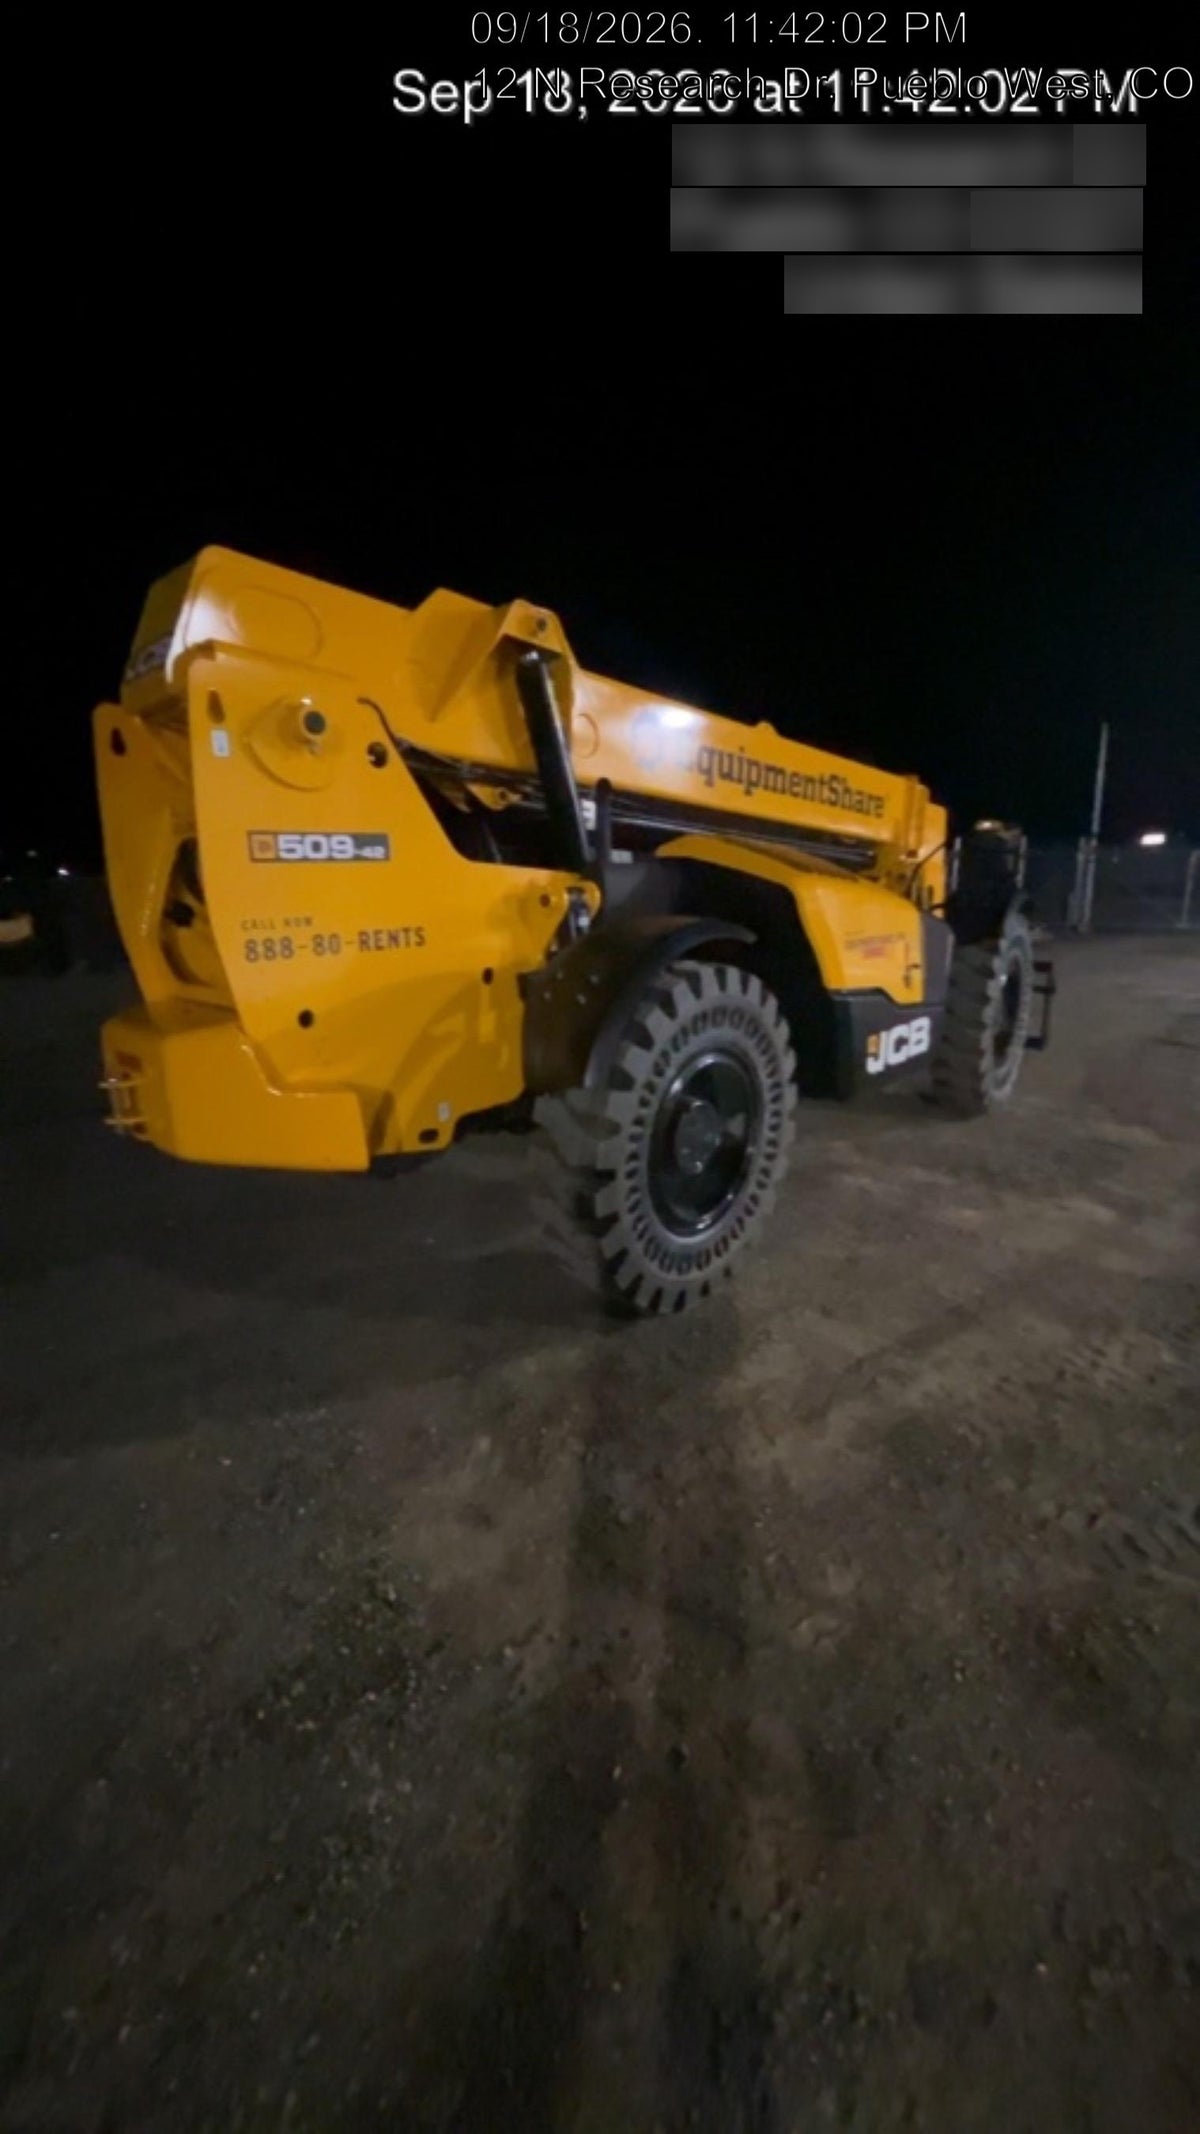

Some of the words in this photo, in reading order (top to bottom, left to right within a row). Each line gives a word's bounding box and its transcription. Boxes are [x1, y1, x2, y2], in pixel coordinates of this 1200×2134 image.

[684, 740, 885, 818] quipmentShare
[240, 917, 277, 932] CALL
[283, 915, 314, 929] NOW
[243, 926, 427, 964] 888-80-RENTS
[866, 1016, 931, 1075] JCB
